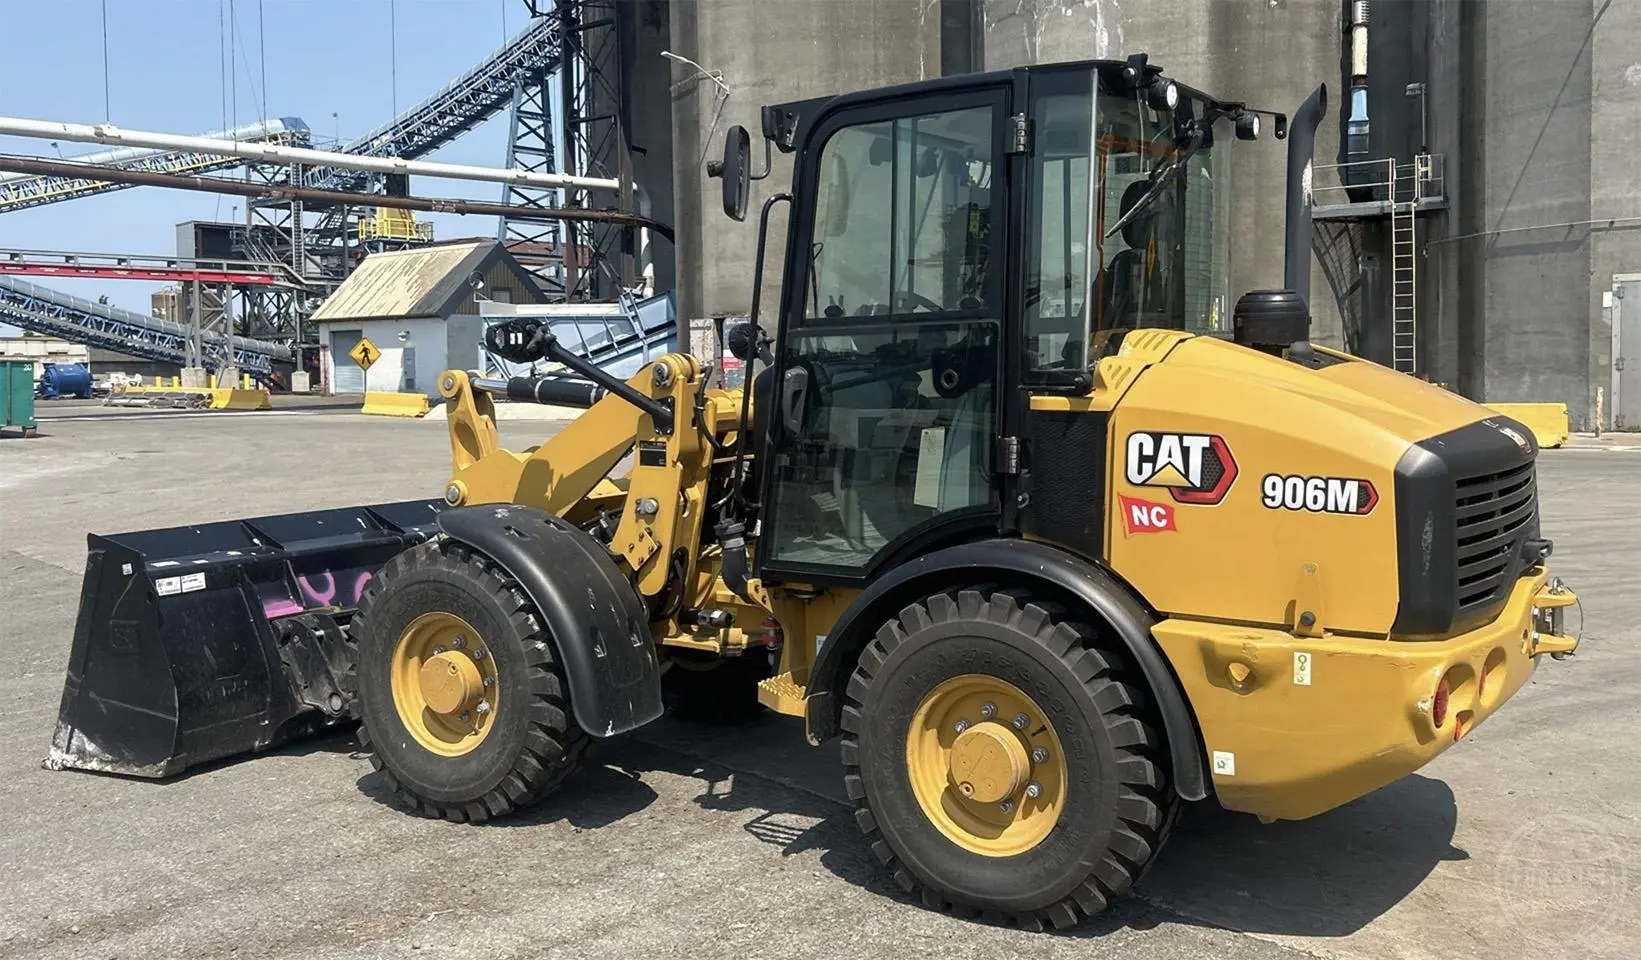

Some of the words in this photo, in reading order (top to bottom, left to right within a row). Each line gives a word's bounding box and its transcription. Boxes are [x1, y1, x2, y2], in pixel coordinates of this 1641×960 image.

[1127, 432, 1210, 488] CAT
[1264, 475, 1359, 512] 906M
[1131, 505, 1168, 528] NC
